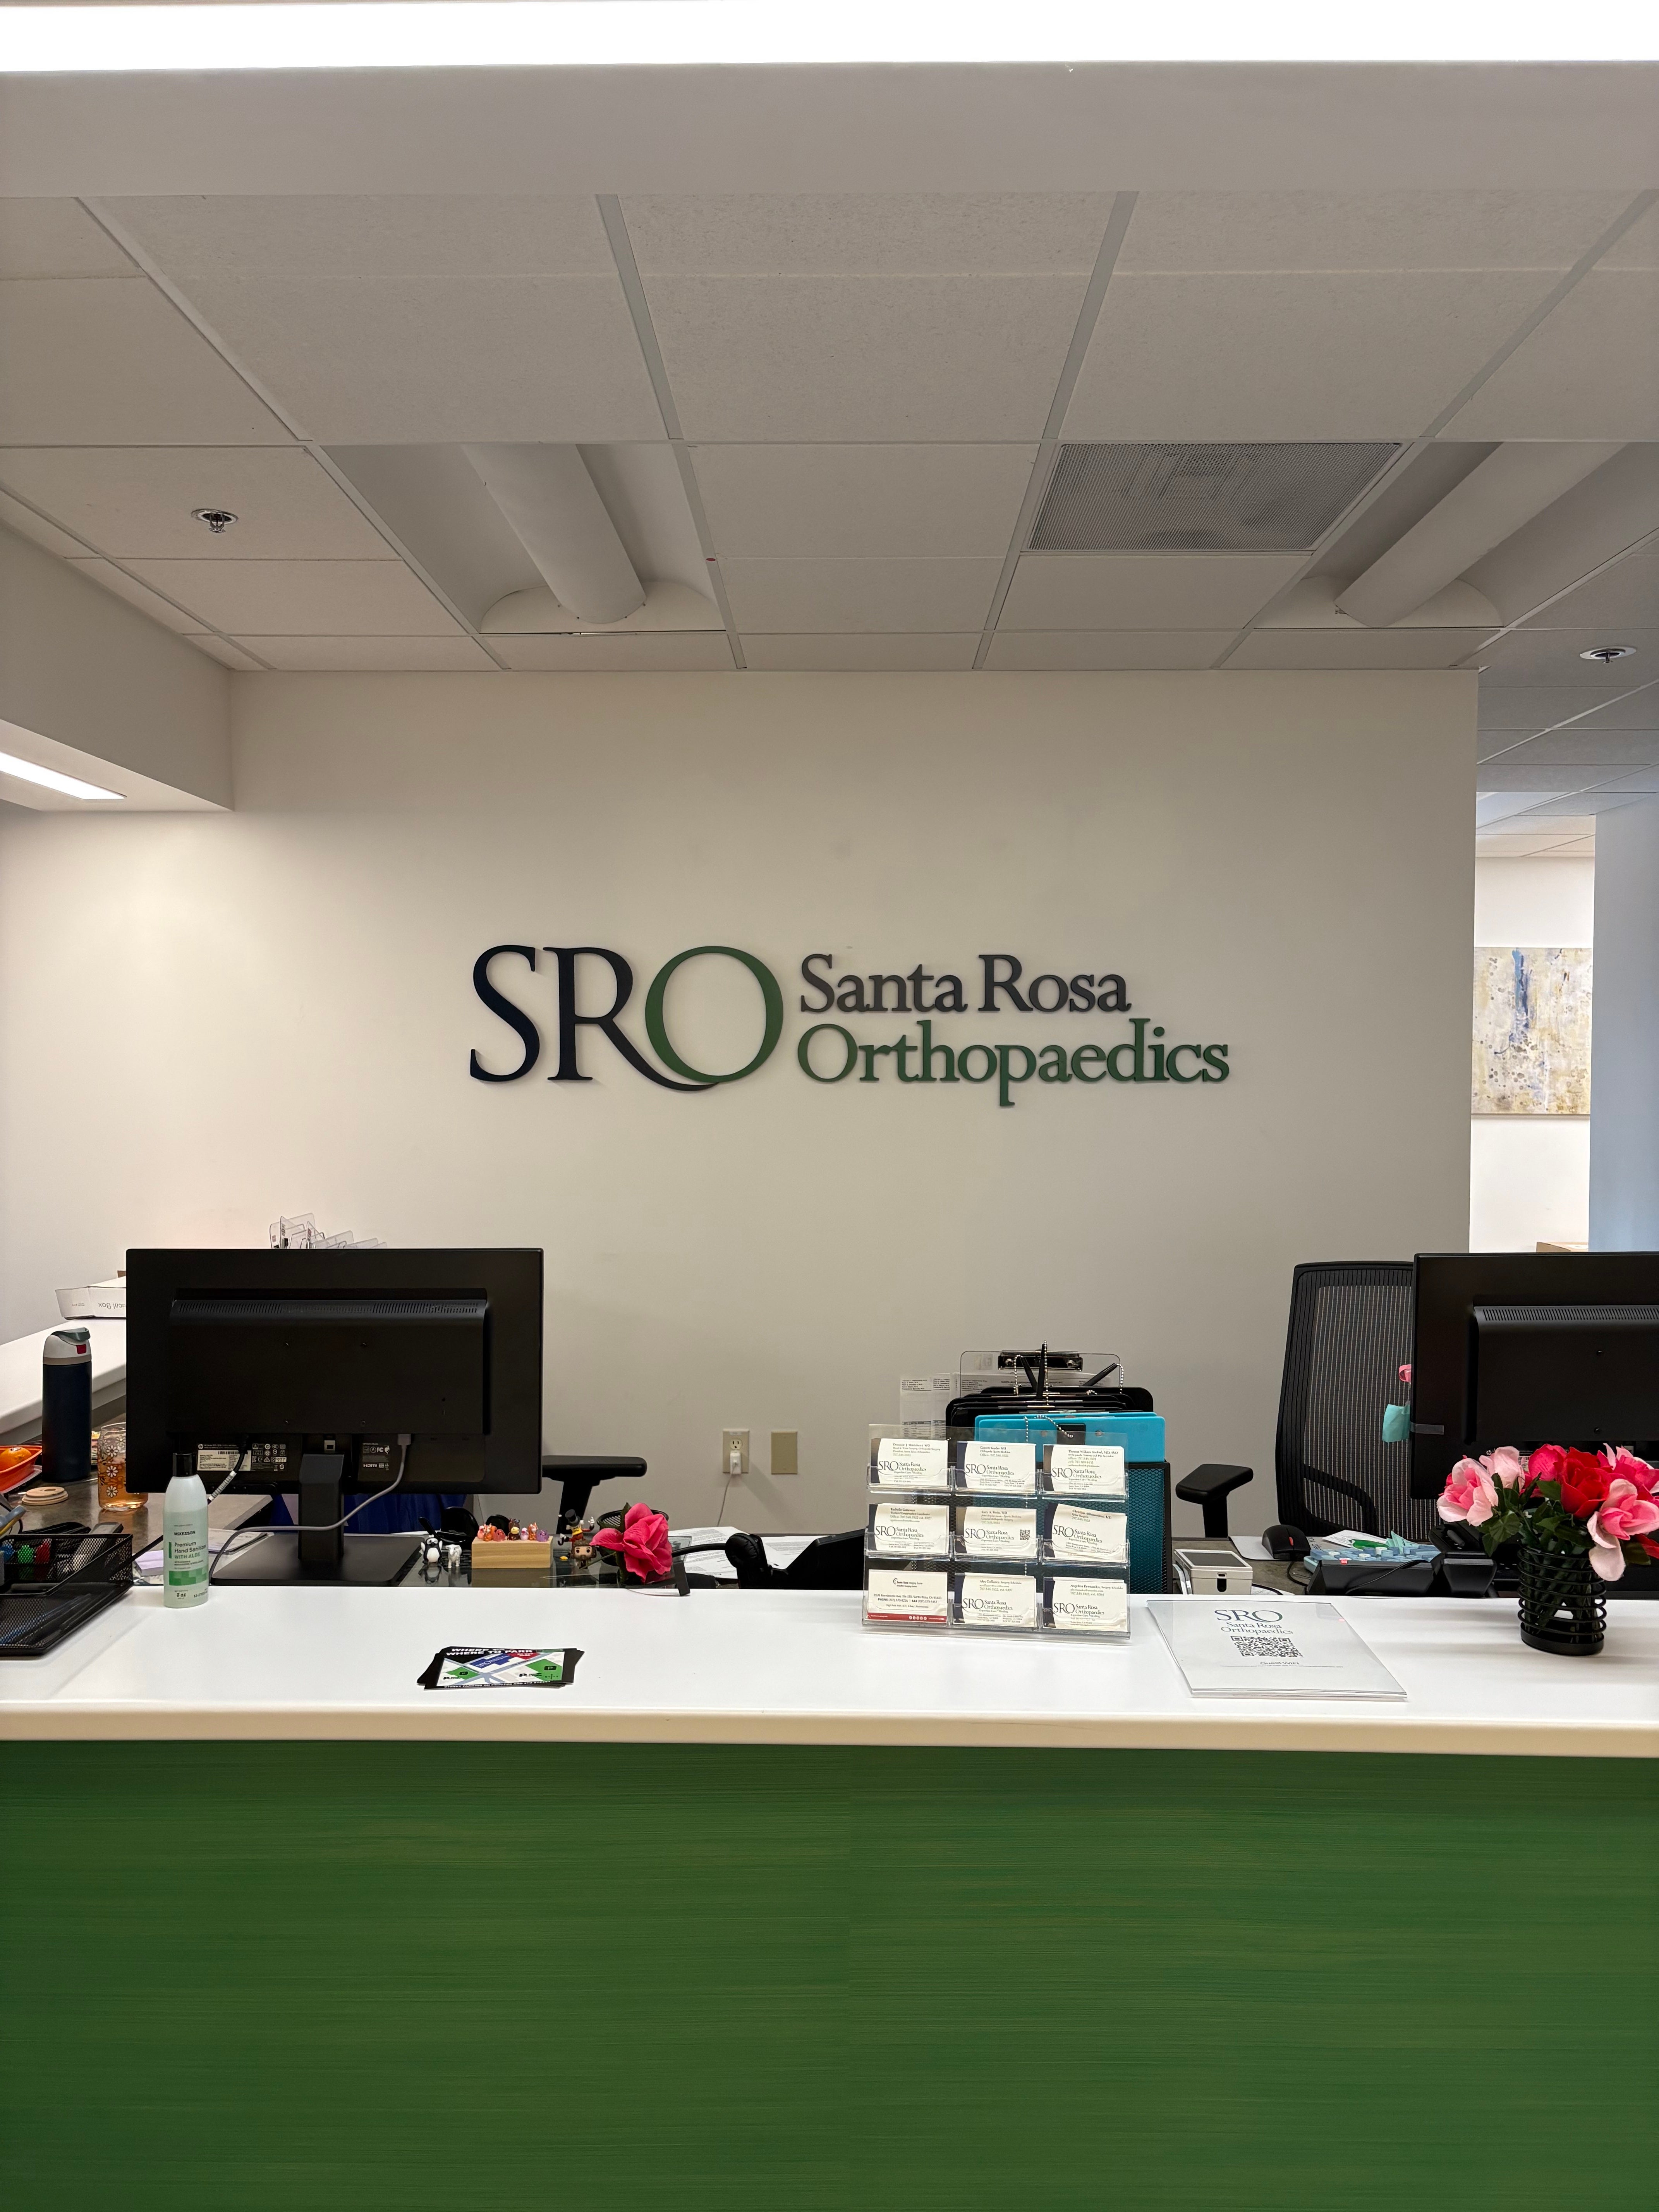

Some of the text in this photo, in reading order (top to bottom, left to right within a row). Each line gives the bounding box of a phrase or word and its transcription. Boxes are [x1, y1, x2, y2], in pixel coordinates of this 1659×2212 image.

[799, 953, 1132, 1013] Santa Rosa
[469, 944, 783, 1092] SRO
[797, 1018, 1229, 1107] Orthopaedics
[879, 1461, 898, 1471] SRO
[966, 1464, 986, 1474] SRO
[1052, 1467, 1073, 1478] SRO
[876, 1526, 895, 1536] SRO
[965, 1528, 986, 1539] SRO
[1053, 1525, 1074, 1537] SRO
[1074, 1534, 1102, 1543] Orthopaedics
[963, 1598, 984, 1609] SRO
[1054, 1603, 1075, 1614] SRO
[1214, 1609, 1283, 1622] SRO
